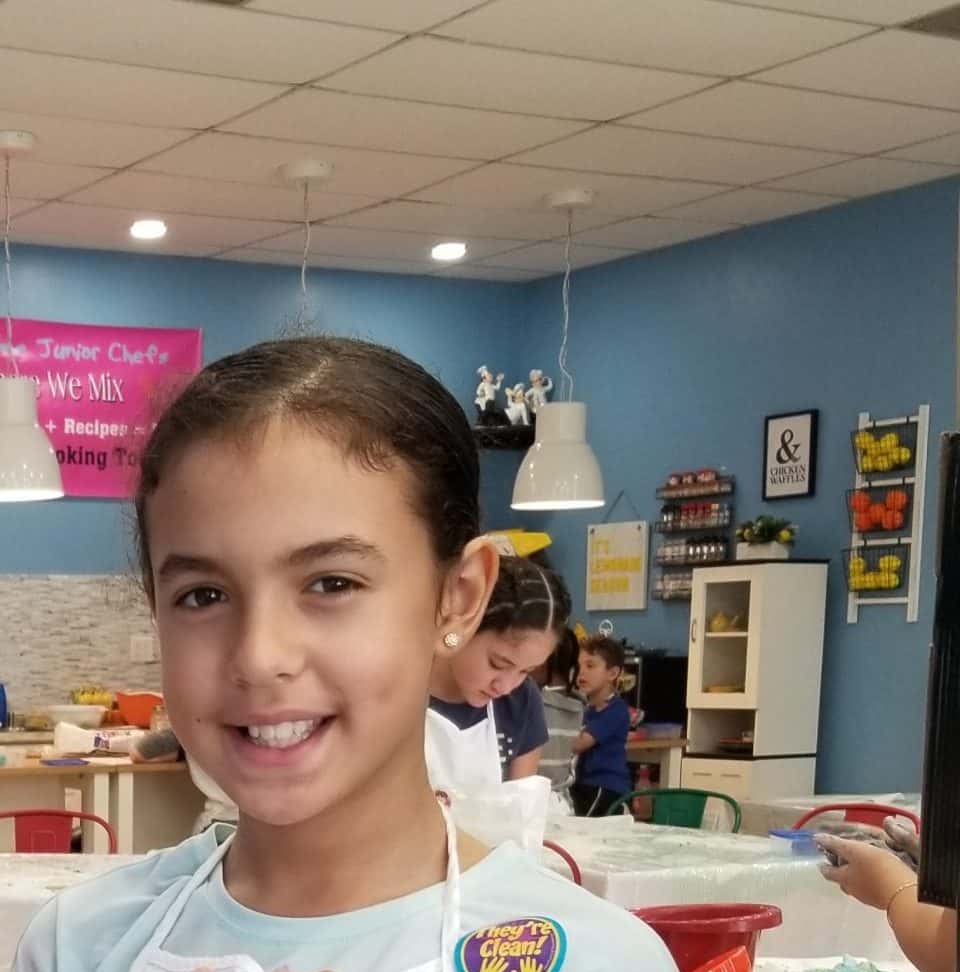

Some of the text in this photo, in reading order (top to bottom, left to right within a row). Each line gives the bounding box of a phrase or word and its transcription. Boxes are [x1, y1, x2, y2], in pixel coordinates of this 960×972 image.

[36, 337, 101, 361] Junior
[107, 342, 169, 366] Chefs
[47, 371, 82, 400] We
[88, 373, 125, 402] Mix
[479, 935, 548, 958] Clean!
